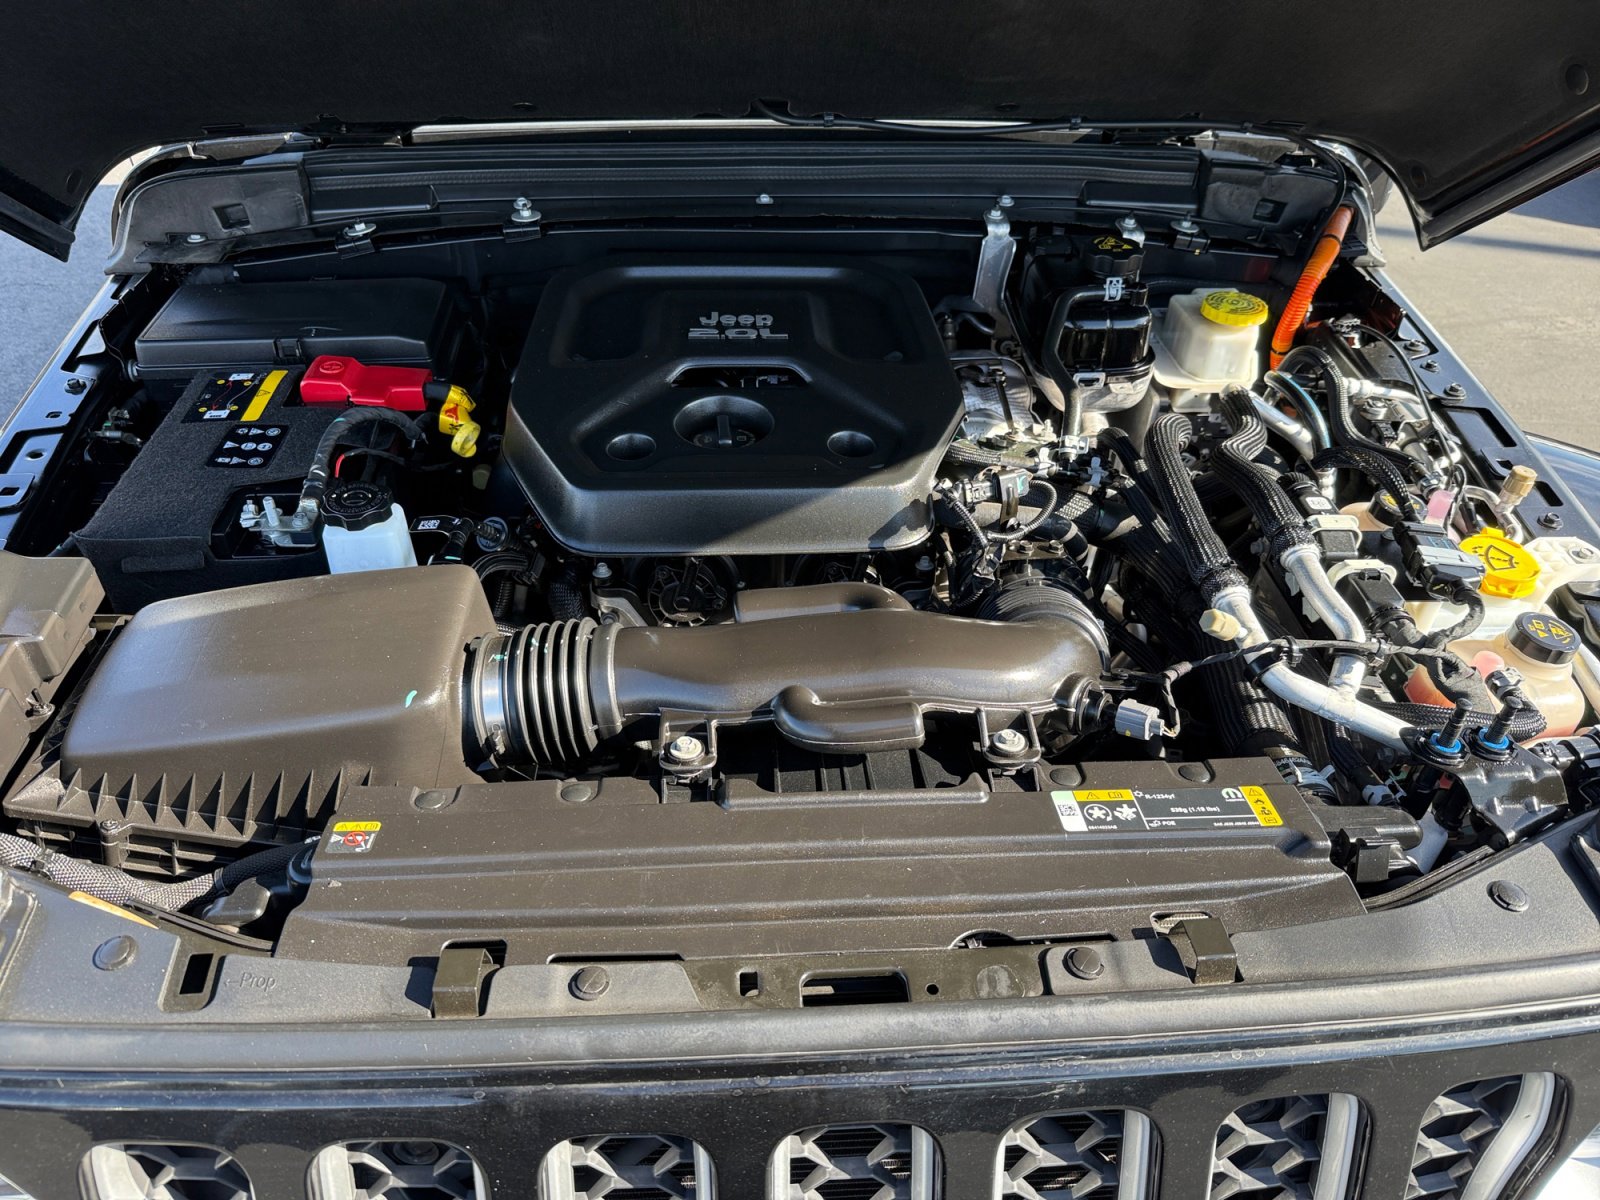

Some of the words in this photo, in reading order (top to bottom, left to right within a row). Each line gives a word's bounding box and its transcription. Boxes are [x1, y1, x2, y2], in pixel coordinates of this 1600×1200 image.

[699, 311, 774, 327] Jeep
[687, 327, 789, 340] 2.0L
[239, 971, 277, 992] Prop
